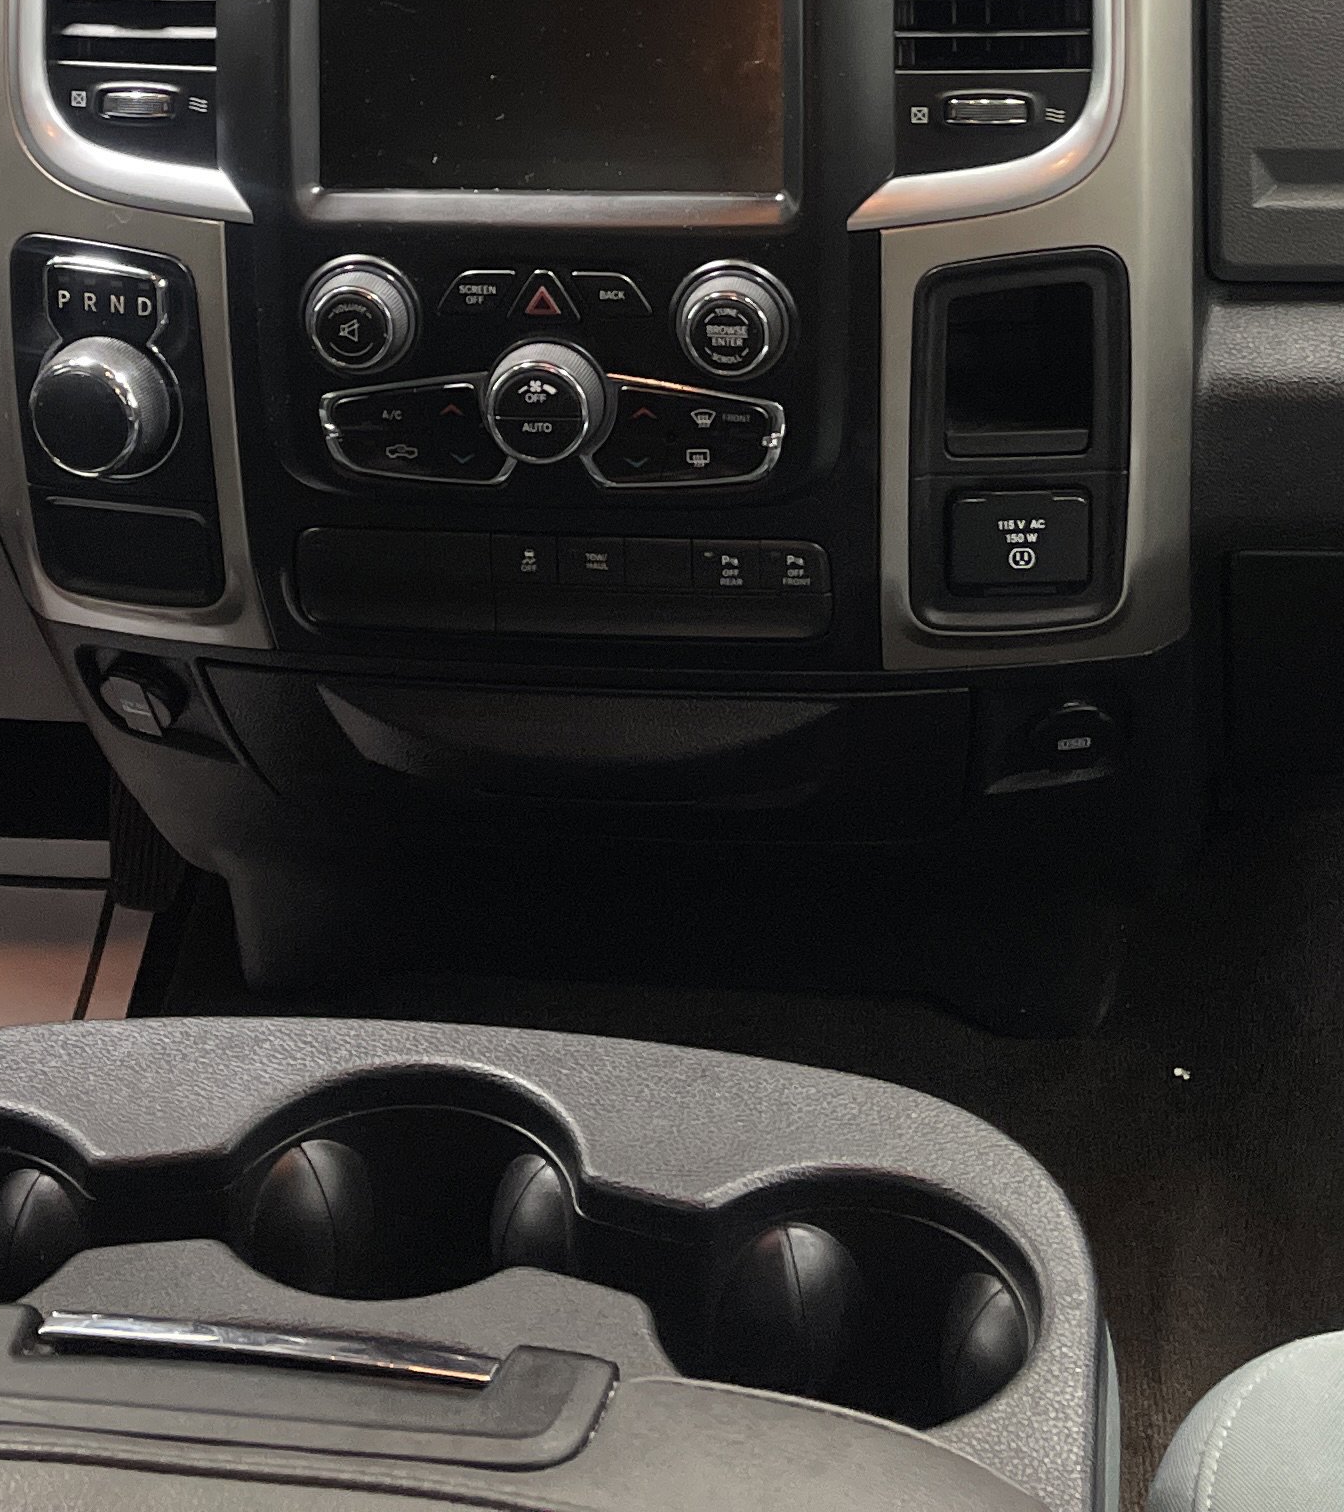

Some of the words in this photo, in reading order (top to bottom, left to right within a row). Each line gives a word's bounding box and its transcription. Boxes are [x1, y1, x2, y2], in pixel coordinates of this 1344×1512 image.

[458, 285, 498, 295] SCREEN
[599, 290, 626, 300] BACK
[58, 289, 71, 309] P
[84, 292, 97, 312] R
[110, 294, 125, 315] N
[137, 296, 152, 316] D
[465, 295, 484, 305] OFF
[706, 325, 748, 335] BROWSE
[711, 337, 744, 347] ENTER
[524, 392, 547, 404] OFF
[382, 409, 402, 421] A/C
[522, 422, 553, 433] AUTO
[997, 519, 1015, 530] 115
[1016, 519, 1026, 530] V
[1029, 519, 1046, 530] AC
[1005, 533, 1025, 544] 150
[1026, 532, 1038, 543] W
